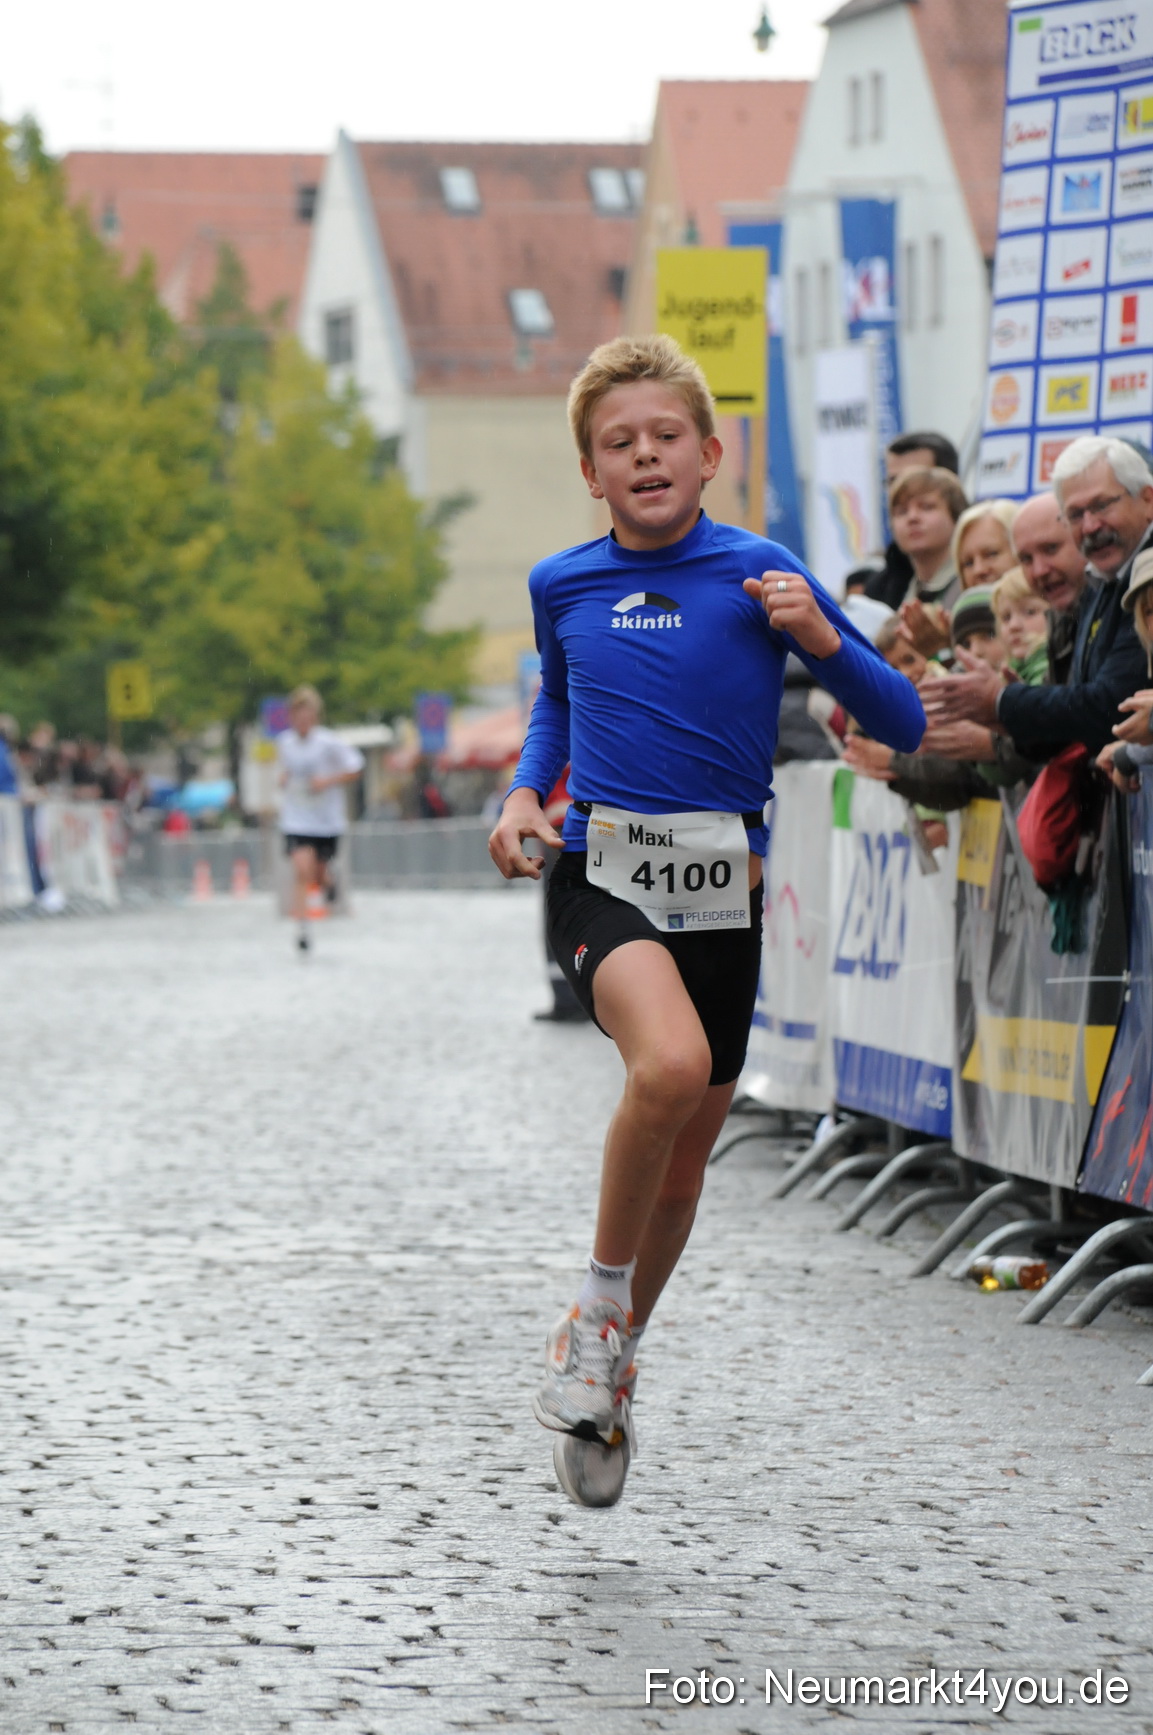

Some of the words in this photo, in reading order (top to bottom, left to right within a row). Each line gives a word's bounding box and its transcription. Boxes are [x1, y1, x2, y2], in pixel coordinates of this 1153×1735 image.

[662, 291, 763, 322] Jugend-
[688, 325, 736, 350] lauf
[611, 613, 682, 630] skinfit
[628, 823, 673, 847] Maxi
[593, 851, 602, 867] J
[631, 860, 732, 894] 4100
[686, 909, 746, 922] PFLEIDERER
